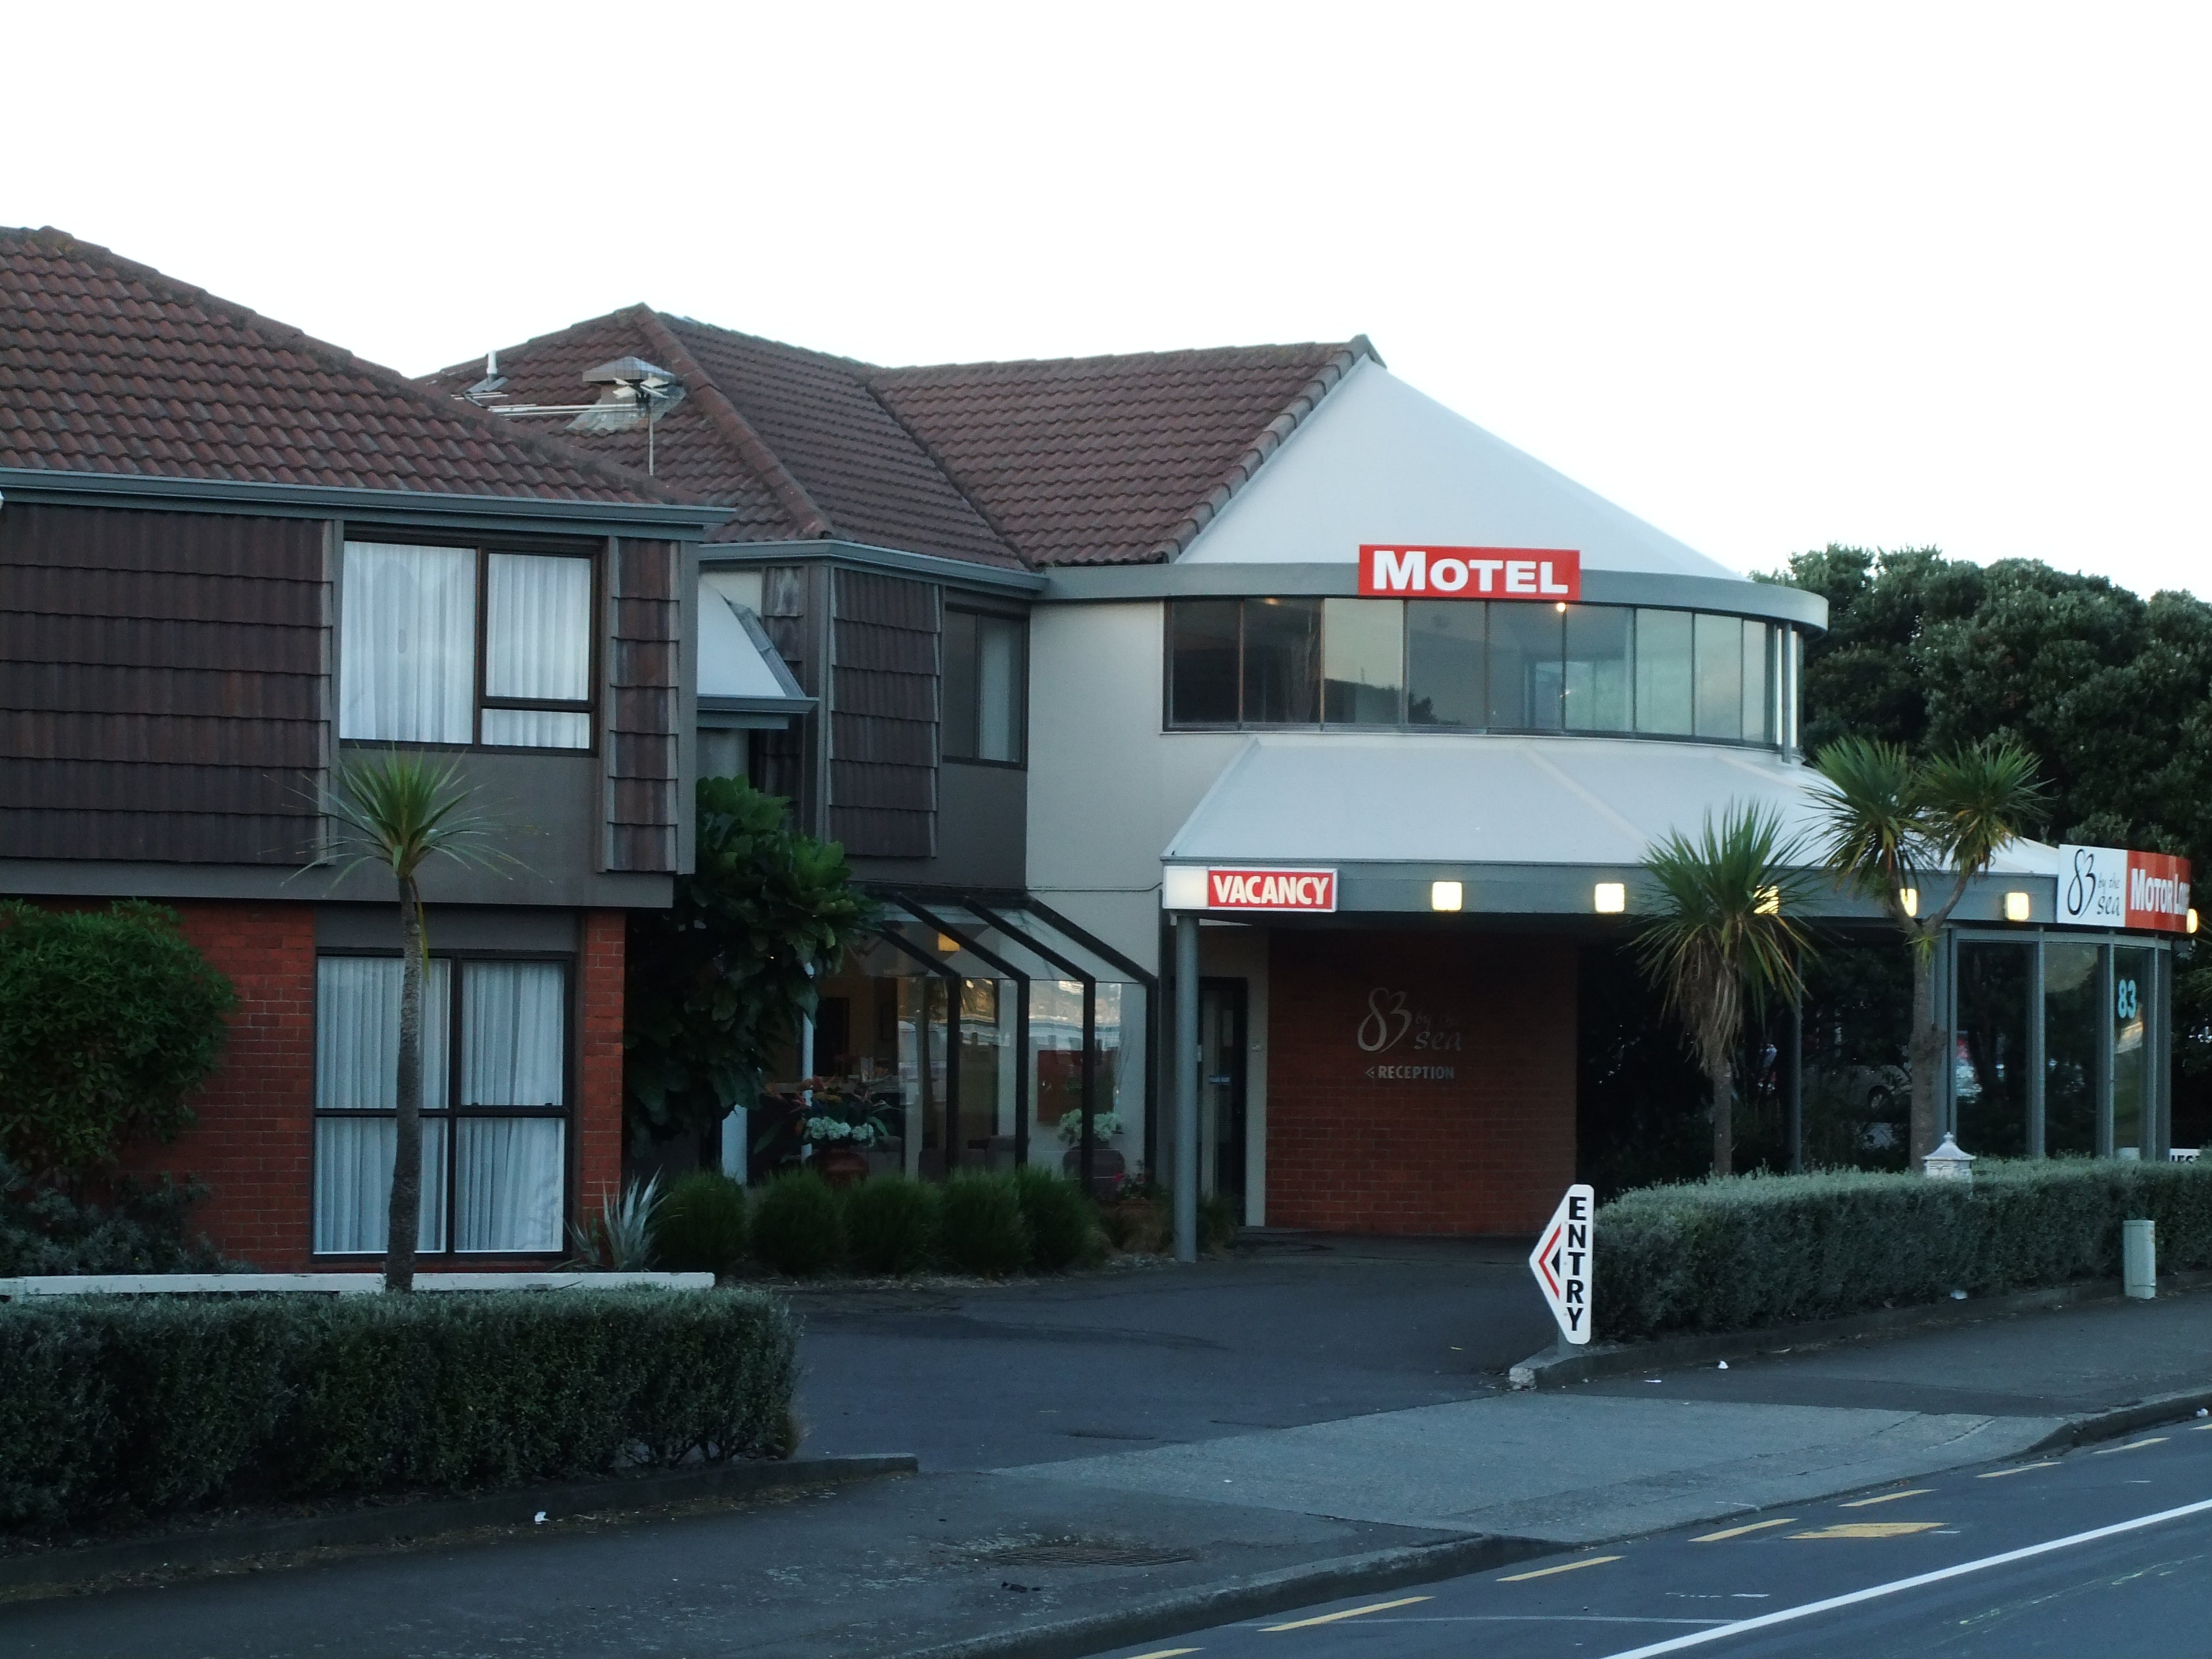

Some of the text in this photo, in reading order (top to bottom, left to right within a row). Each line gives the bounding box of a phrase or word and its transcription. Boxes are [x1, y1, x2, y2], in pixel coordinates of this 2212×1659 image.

[1373, 550, 1569, 594] MOTEL
[1213, 875, 1330, 905] VACANCY
[2067, 849, 2096, 919] 83
[2097, 896, 2120, 916] sea
[2118, 979, 2137, 1019] 83
[1357, 987, 1411, 1053] 83
[1414, 1031, 1461, 1051] sea
[1377, 1065, 1455, 1079] RECEPTION
[1566, 1196, 1587, 1331] ENTRY
